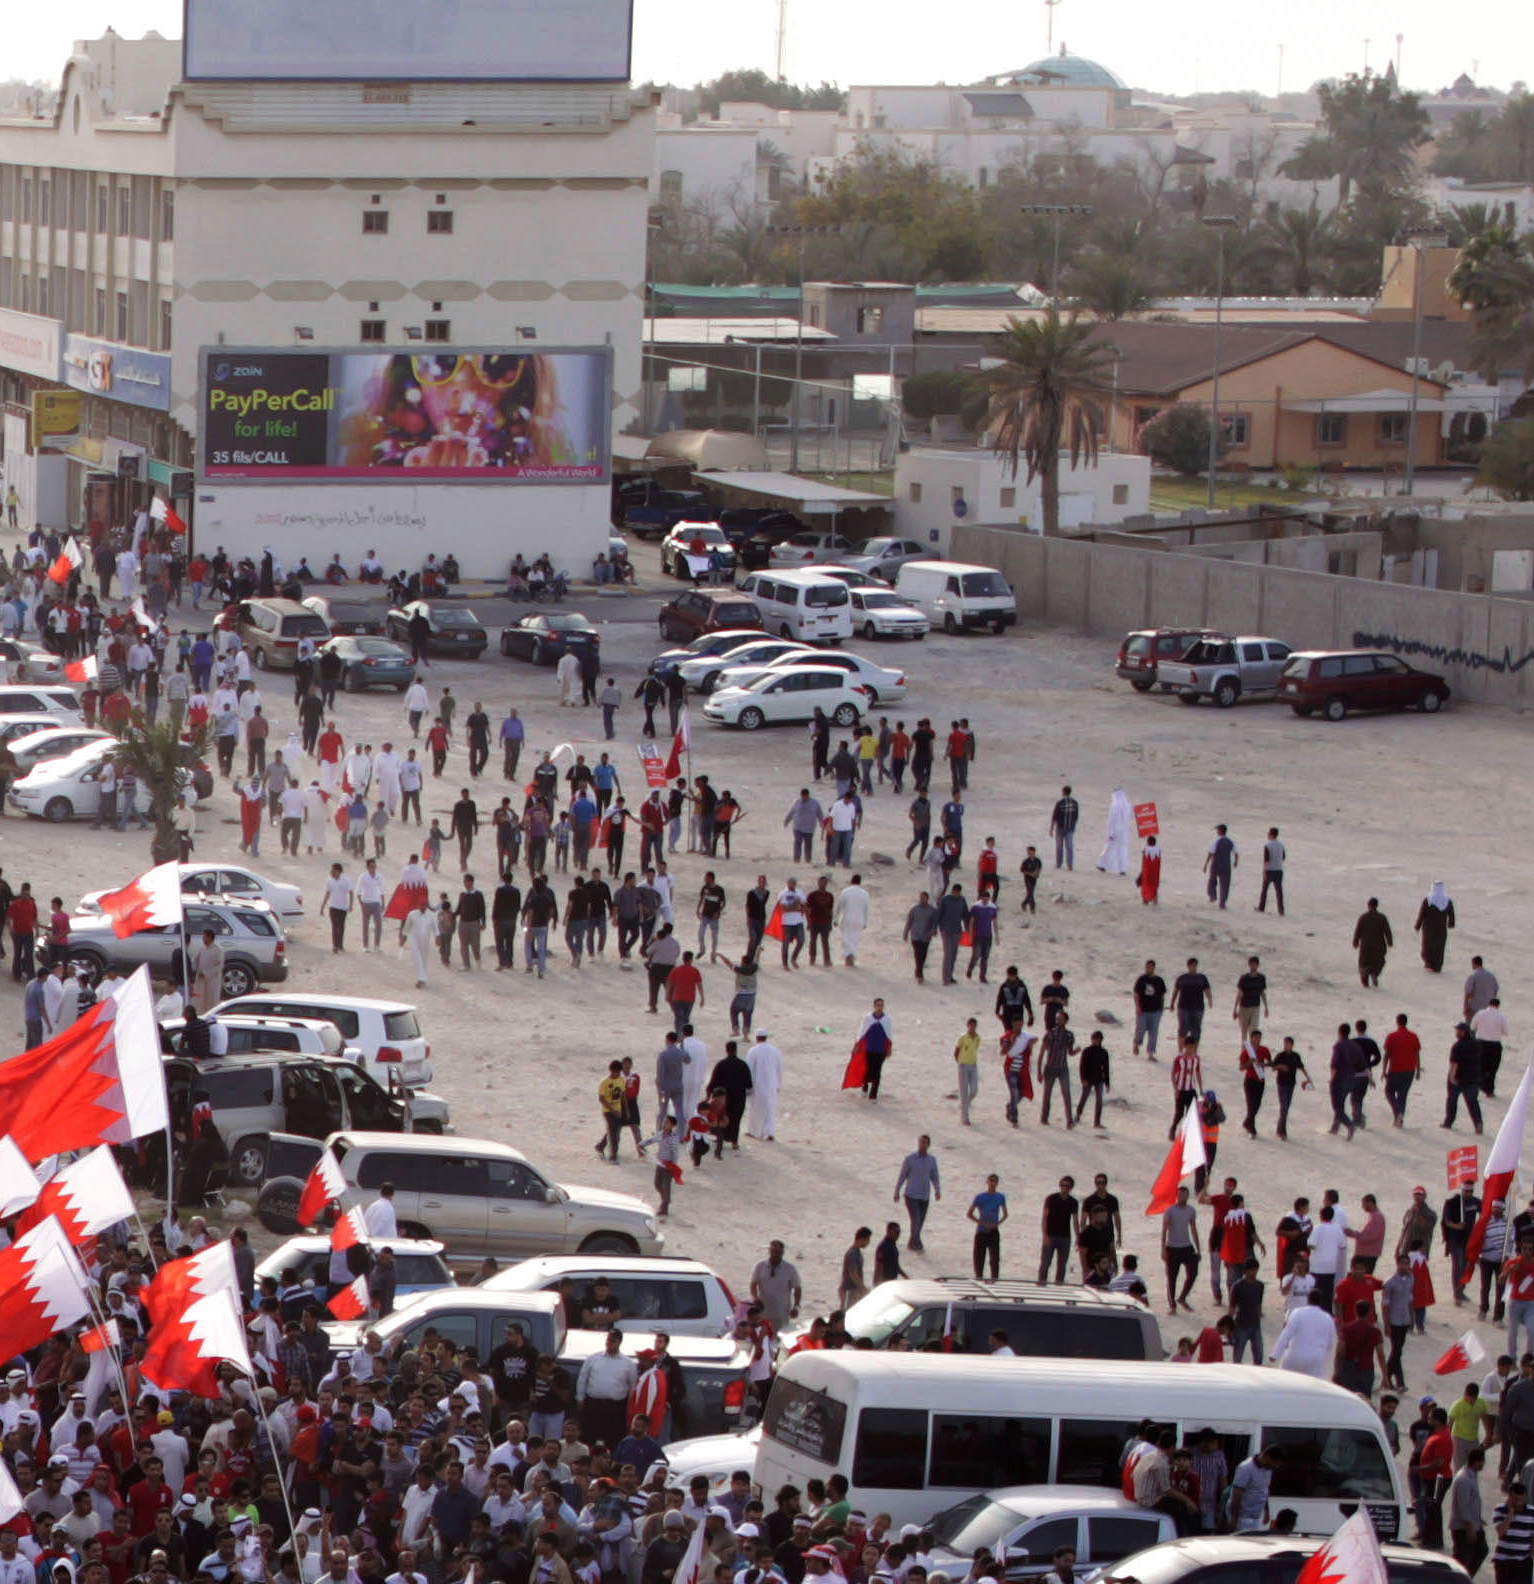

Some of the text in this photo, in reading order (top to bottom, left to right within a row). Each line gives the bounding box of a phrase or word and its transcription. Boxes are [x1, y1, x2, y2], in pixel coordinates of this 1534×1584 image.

[210, 389, 334, 417] PayPerCall
[235, 418, 297, 437] for life!
[212, 449, 289, 465] 35 fils/CALL
